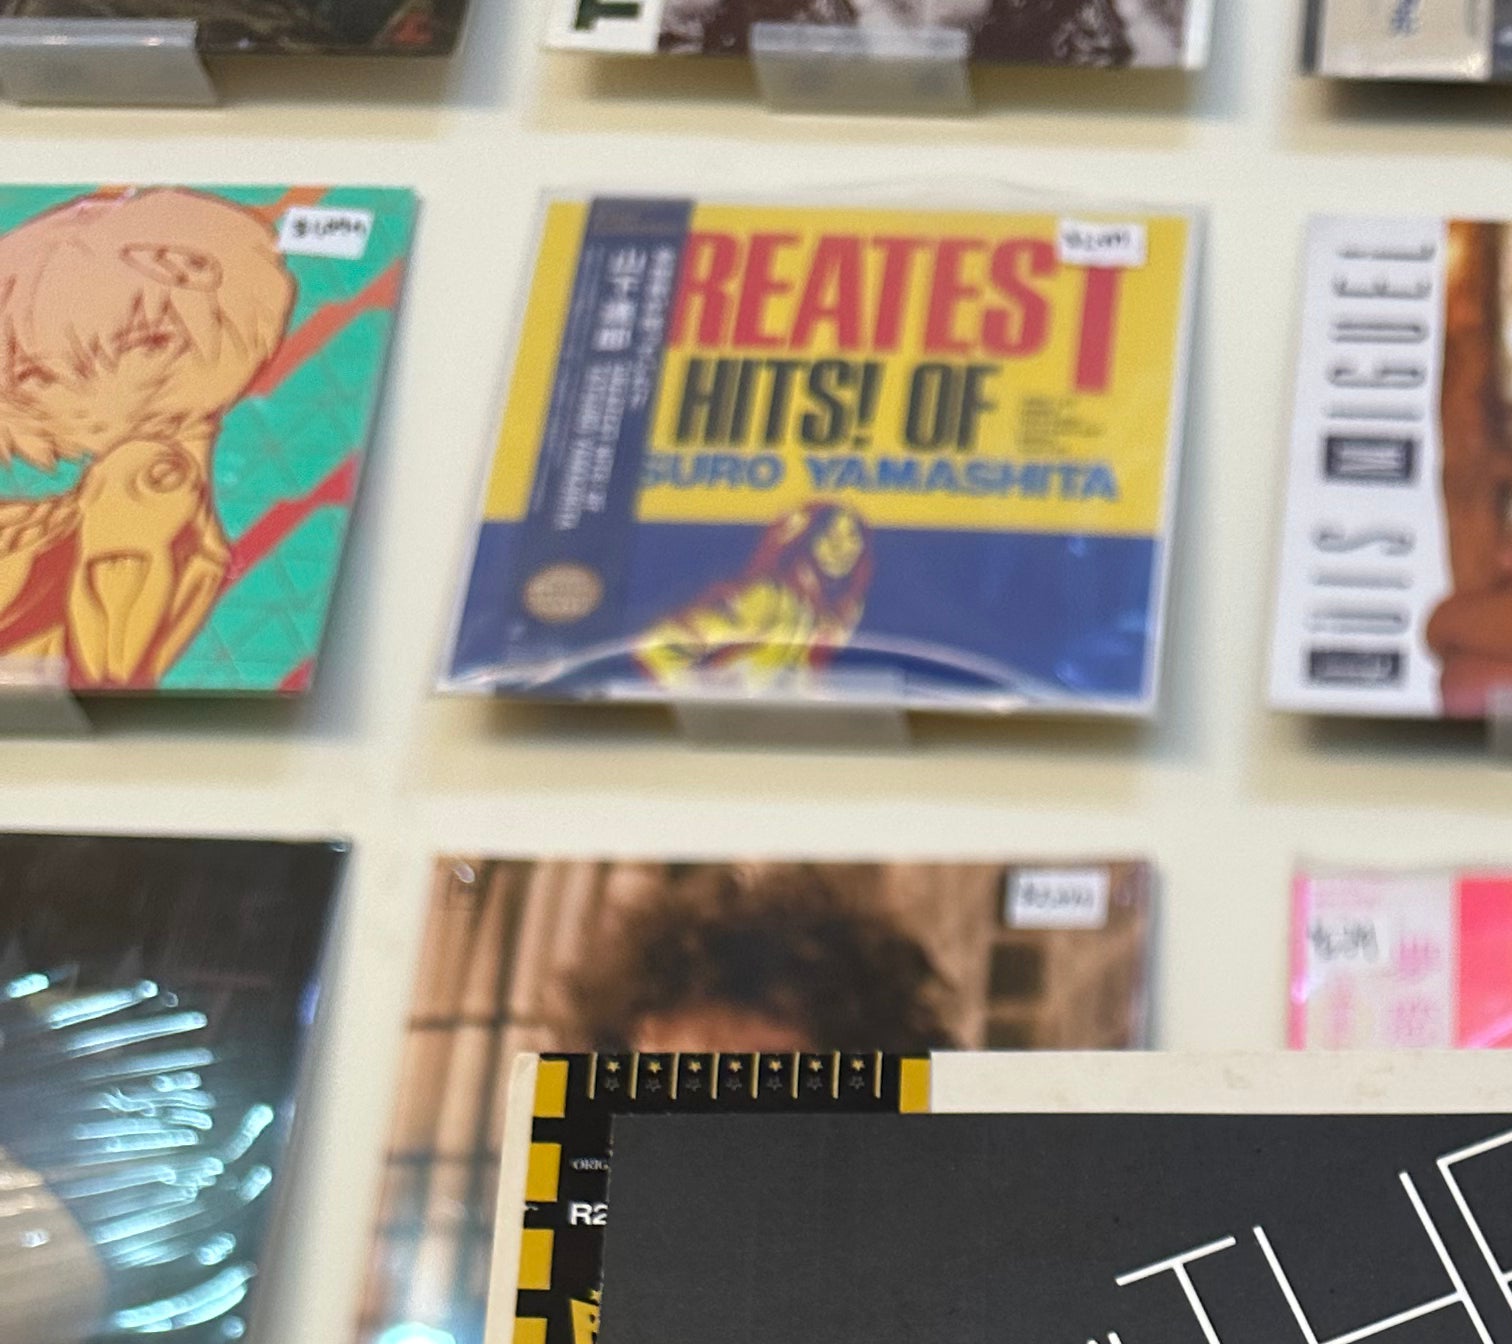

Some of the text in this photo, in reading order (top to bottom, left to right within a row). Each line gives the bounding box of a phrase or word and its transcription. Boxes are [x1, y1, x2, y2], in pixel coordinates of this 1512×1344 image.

[672, 356, 886, 450] HITS!
[903, 359, 1003, 453] OF
[806, 456, 1121, 503] YAMASHITA
